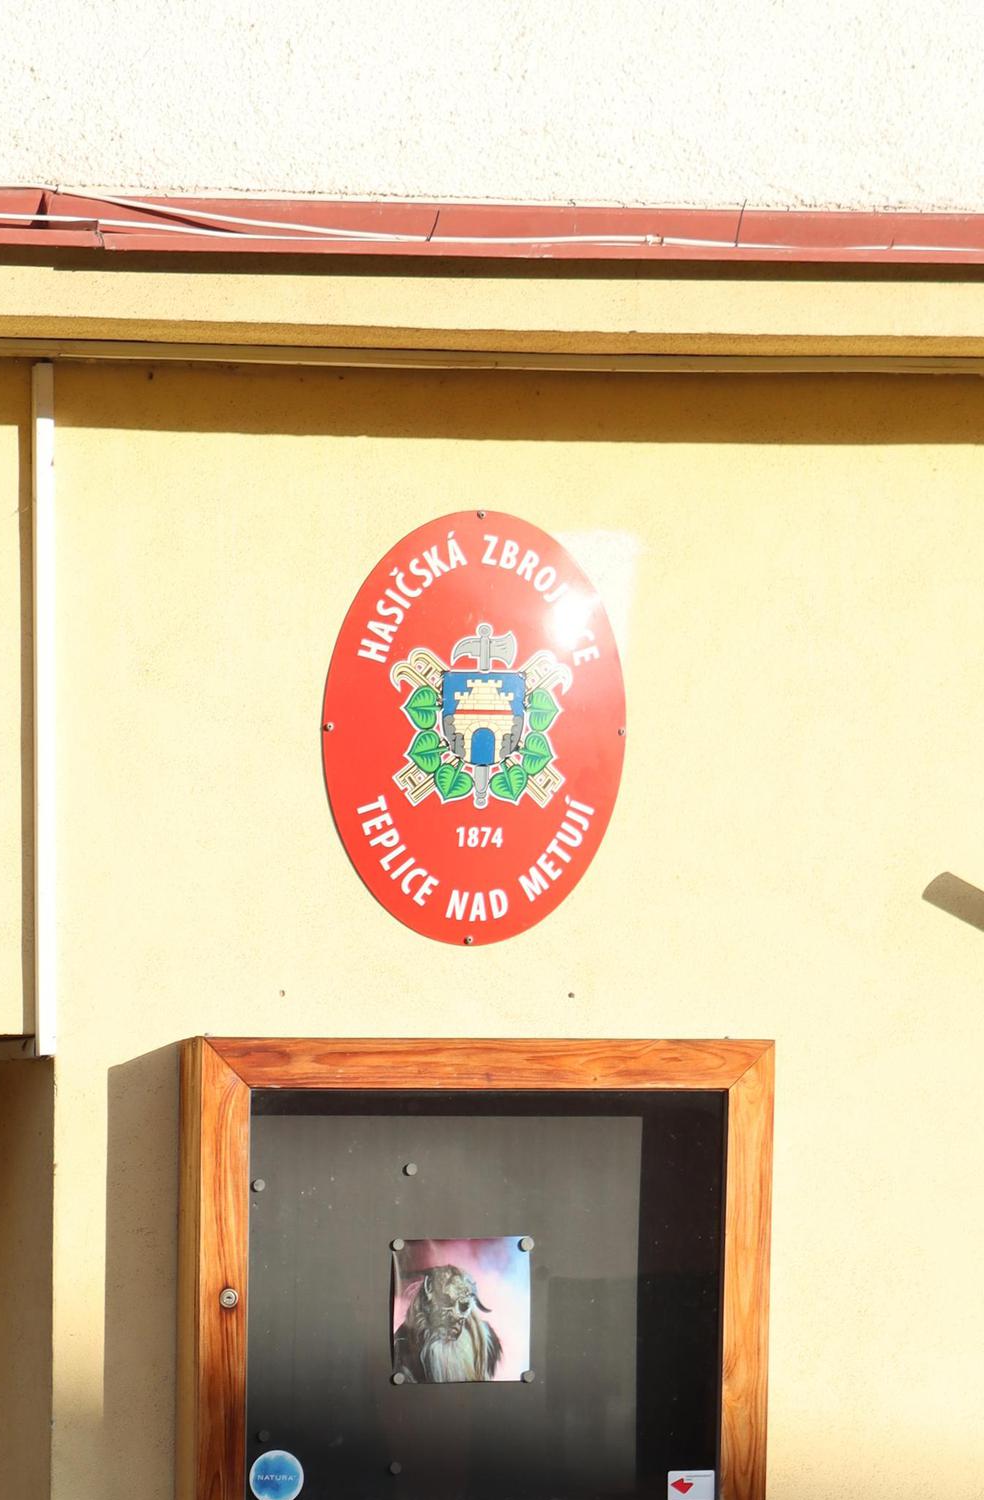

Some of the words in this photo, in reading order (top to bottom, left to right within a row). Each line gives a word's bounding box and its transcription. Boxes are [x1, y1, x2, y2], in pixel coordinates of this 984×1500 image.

[358, 532, 468, 663] HASIČSKÁ
[357, 796, 439, 906] TEPLICE
[445, 888, 509, 922] NAD
[518, 794, 596, 902] METUJÍ
[456, 826, 503, 848] 1874
